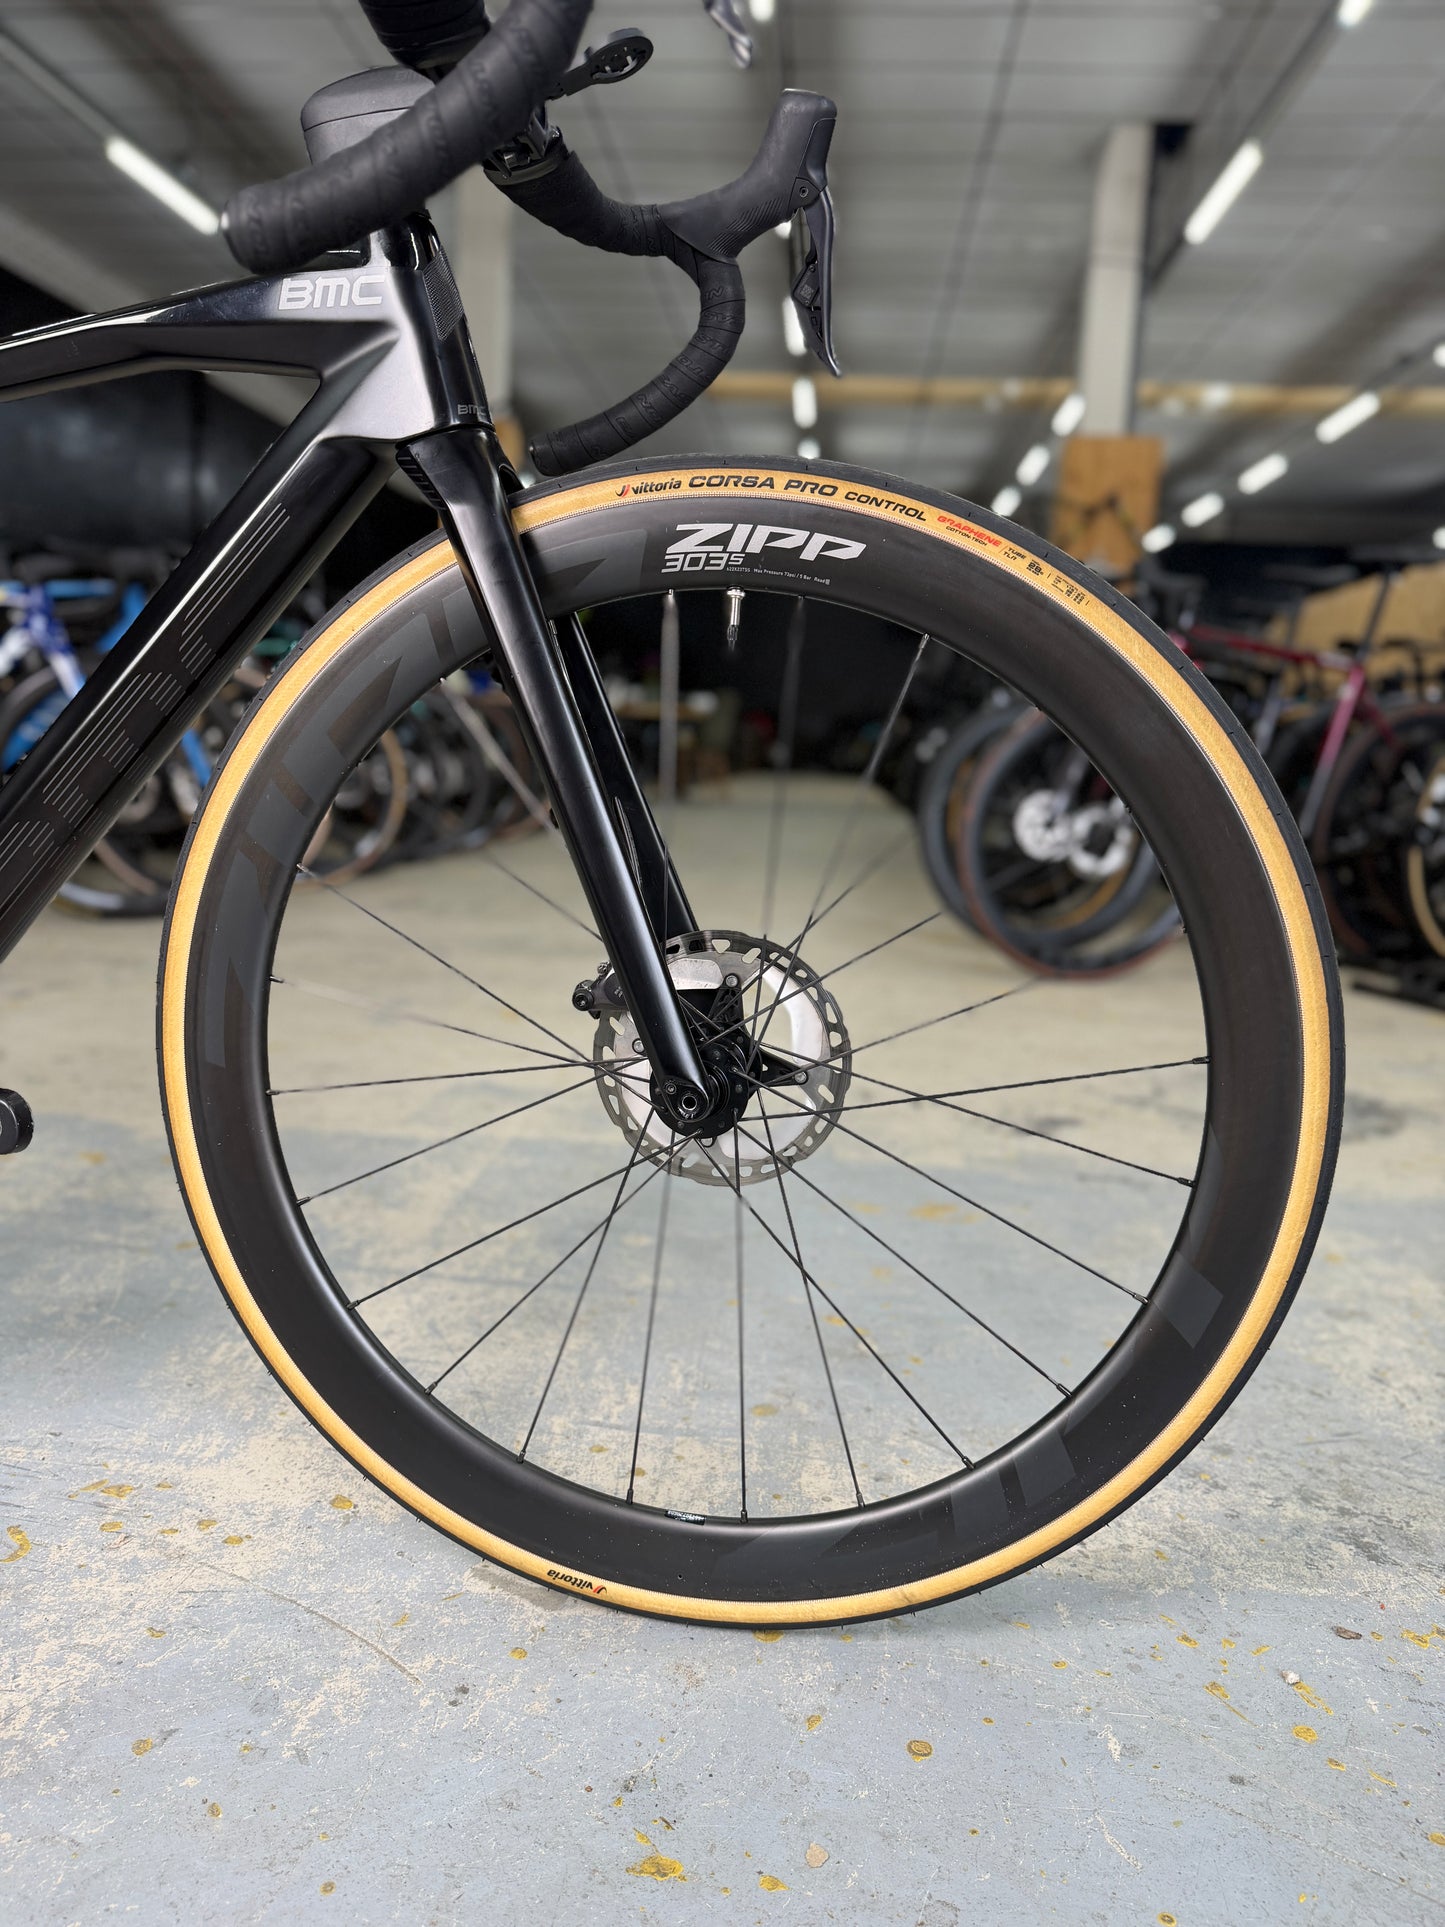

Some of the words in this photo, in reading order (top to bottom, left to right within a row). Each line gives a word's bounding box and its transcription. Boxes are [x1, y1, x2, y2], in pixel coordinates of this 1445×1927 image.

[279, 274, 386, 310] BMC
[457, 403, 487, 416] BMC
[631, 478, 682, 495] vittoria
[688, 475, 775, 490] CORSA
[784, 479, 839, 497] PRO
[844, 491, 927, 522] CONTROL
[666, 523, 867, 562] ZIPP
[936, 515, 1002, 547] GRAPHENE
[763, 568, 784, 576] Pressure
[547, 1569, 593, 1590] vittoria
